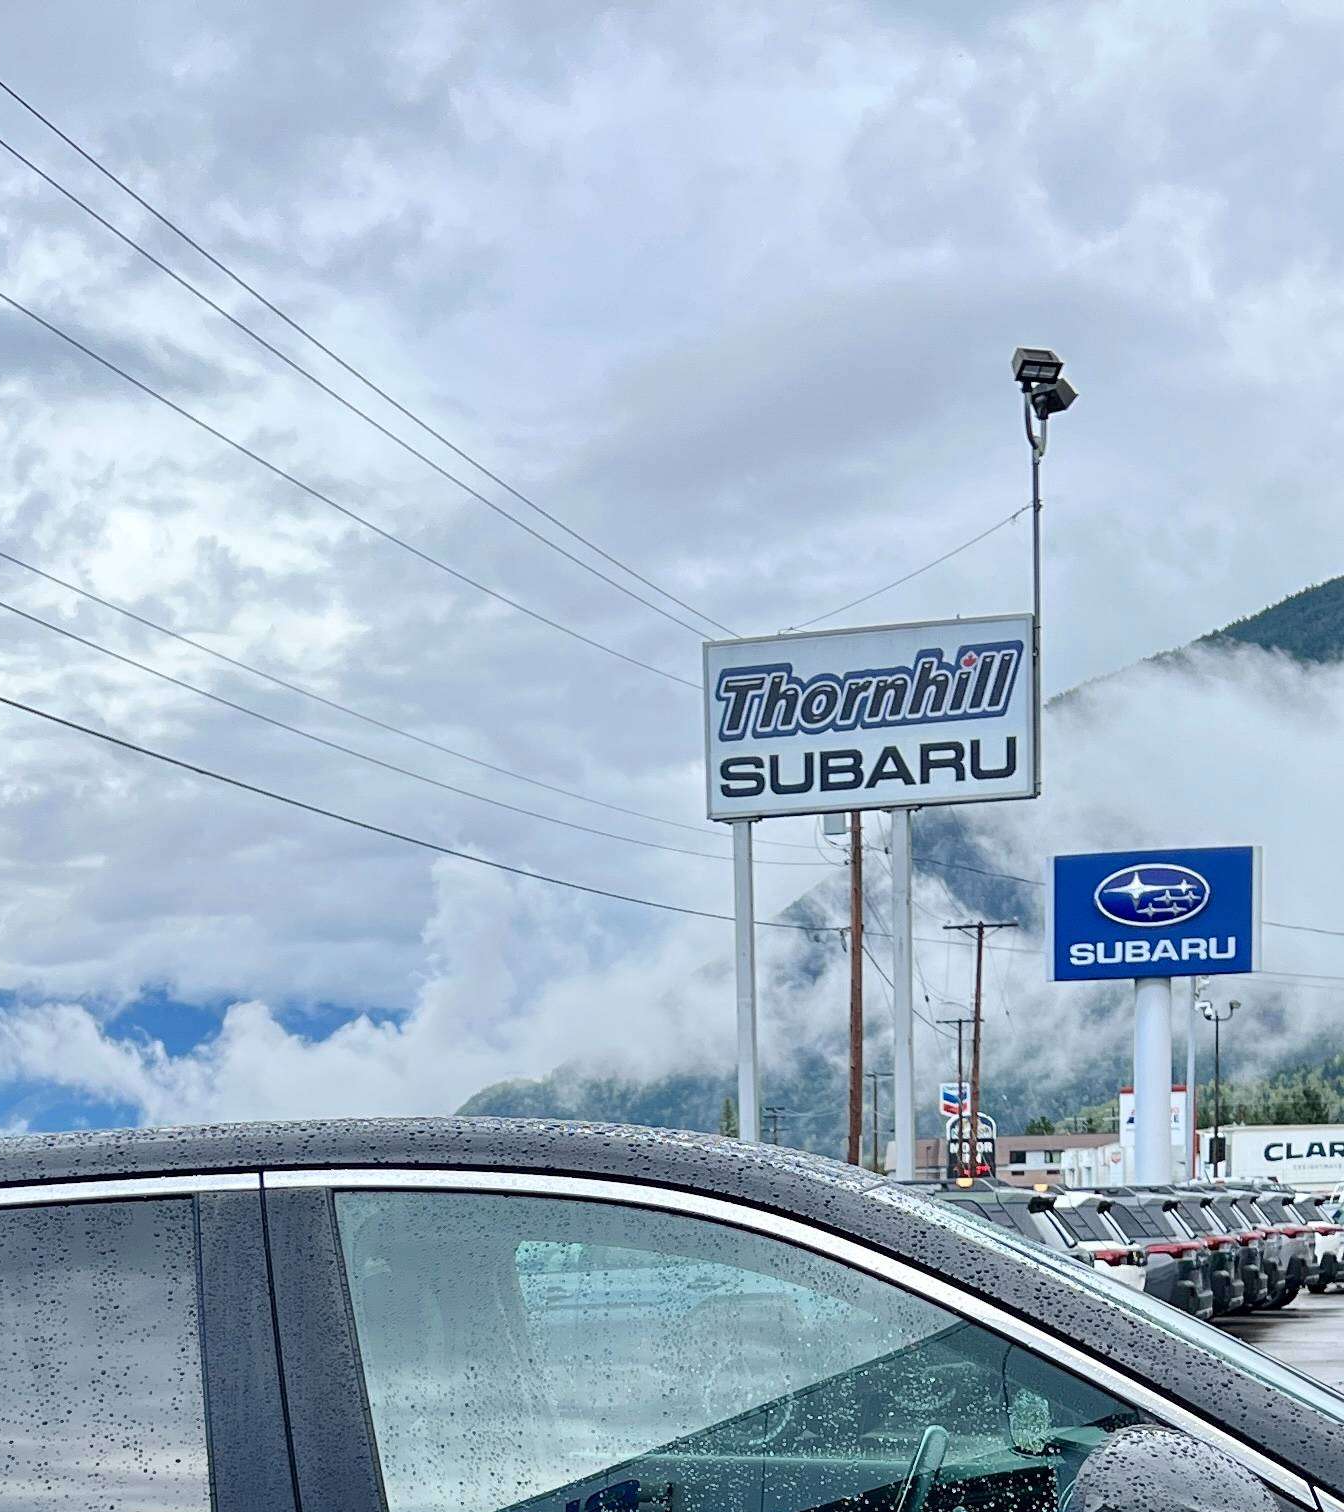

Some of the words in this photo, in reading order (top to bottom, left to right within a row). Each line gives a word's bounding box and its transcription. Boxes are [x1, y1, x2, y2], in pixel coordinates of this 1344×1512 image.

[718, 645, 1022, 740] Thornhill
[720, 736, 1017, 798] SUBARU
[1069, 936, 1237, 966] SUBARU
